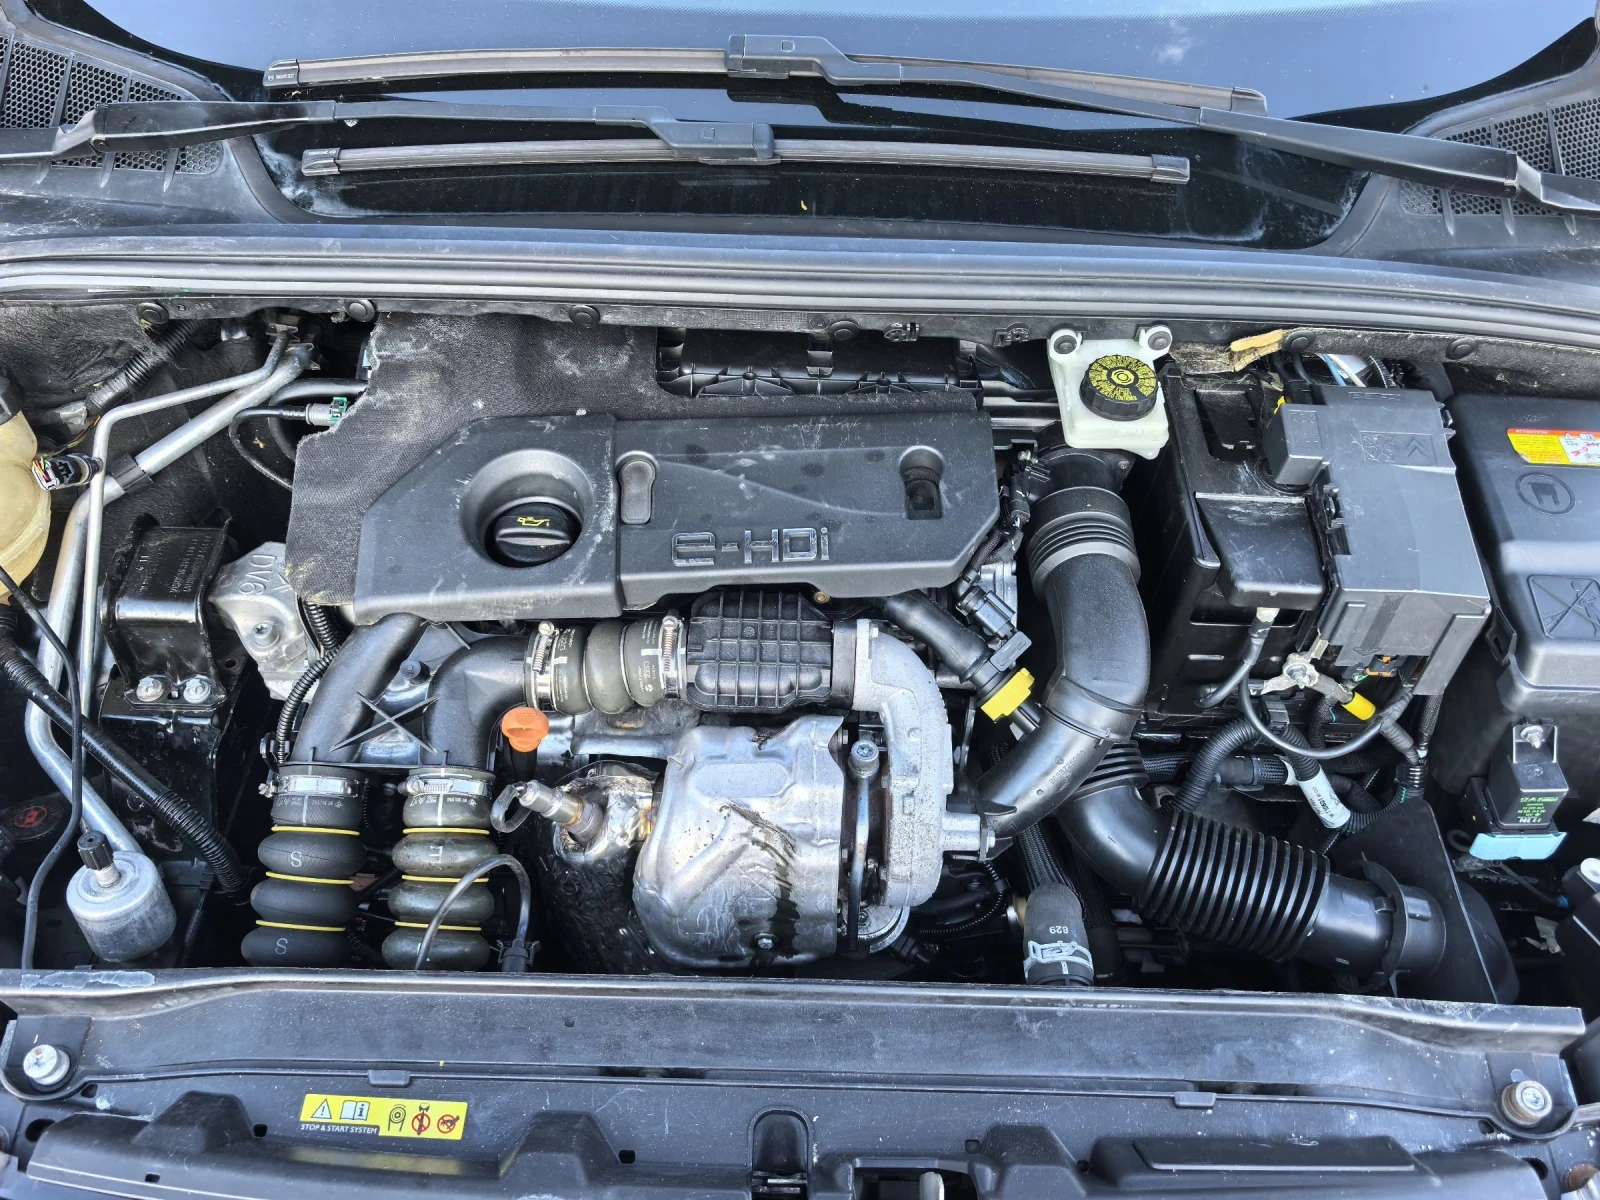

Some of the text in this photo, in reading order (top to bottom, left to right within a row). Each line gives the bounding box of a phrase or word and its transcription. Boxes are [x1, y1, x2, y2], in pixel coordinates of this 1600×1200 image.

[290, 850, 302, 868] S
[1049, 925, 1069, 935] 829
[275, 937, 288, 955] S
[300, 1123, 320, 1131] STOP
[350, 1126, 378, 1134] SYSTEM
